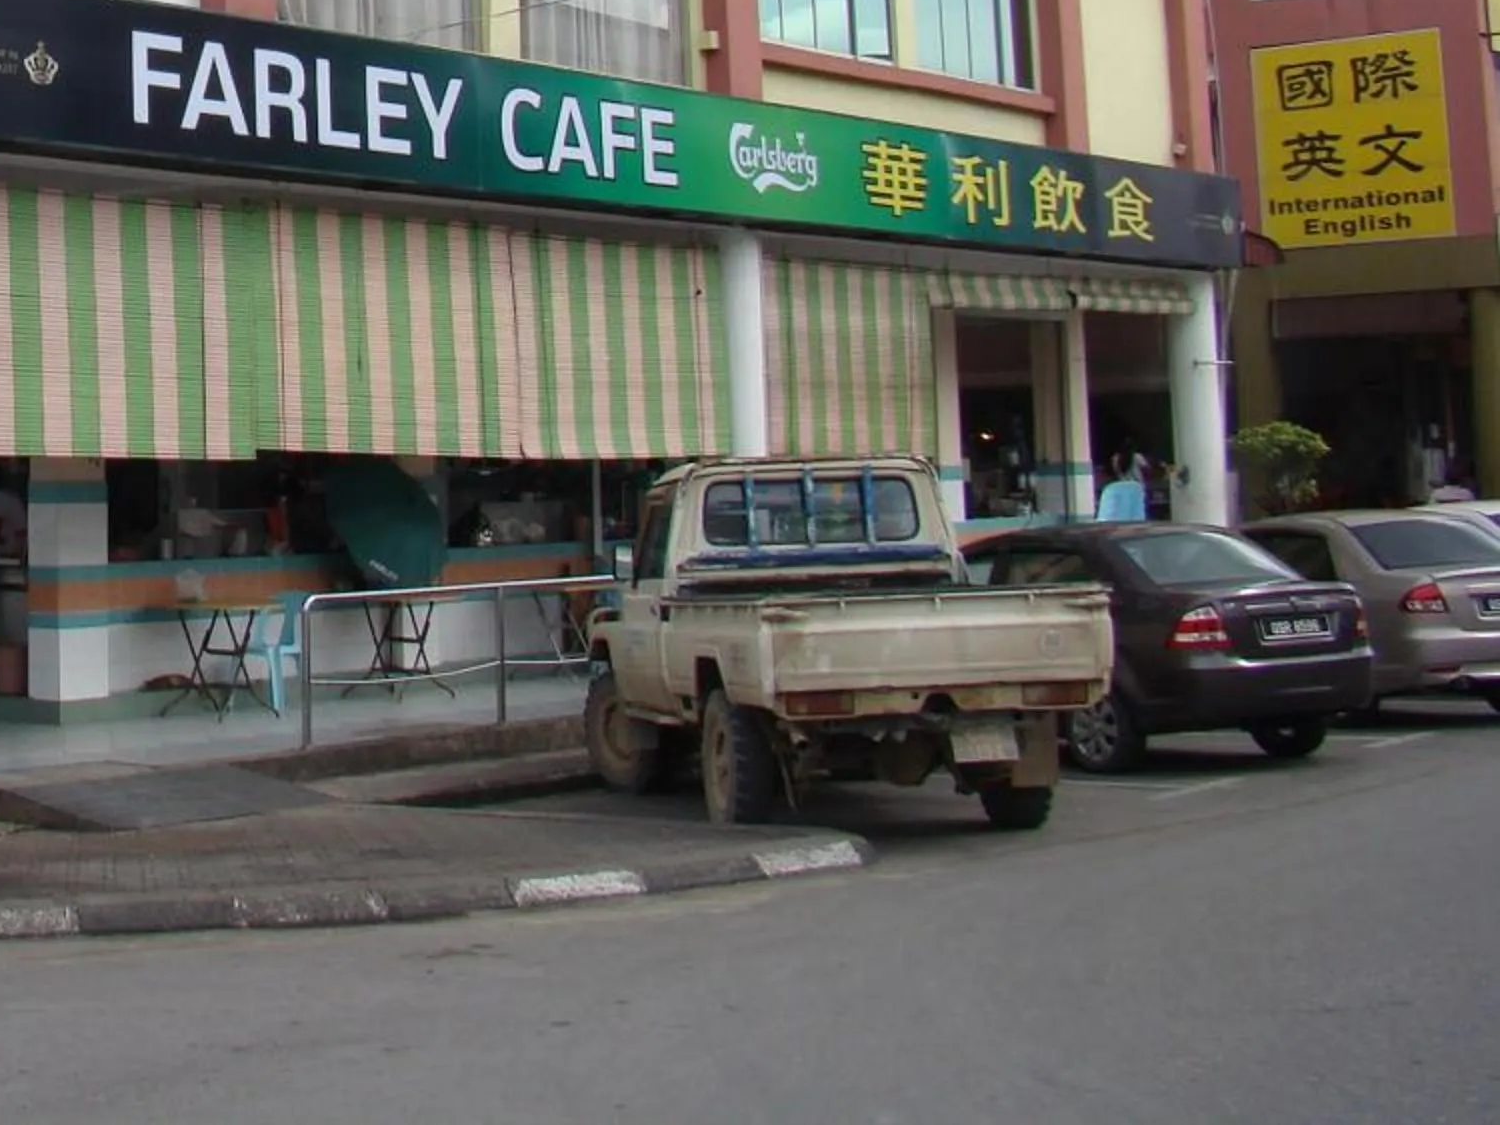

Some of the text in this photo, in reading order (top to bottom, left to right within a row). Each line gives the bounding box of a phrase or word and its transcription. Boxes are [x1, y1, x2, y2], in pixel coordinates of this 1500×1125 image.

[130, 29, 680, 187] FARLEY CAFE
[1275, 49, 1419, 112] 國際
[729, 122, 818, 190] Carlsberg
[1280, 123, 1425, 183] 英文
[860, 138, 1156, 243] 華利飲食
[1268, 184, 1446, 217] International
[1303, 211, 1412, 238] English
